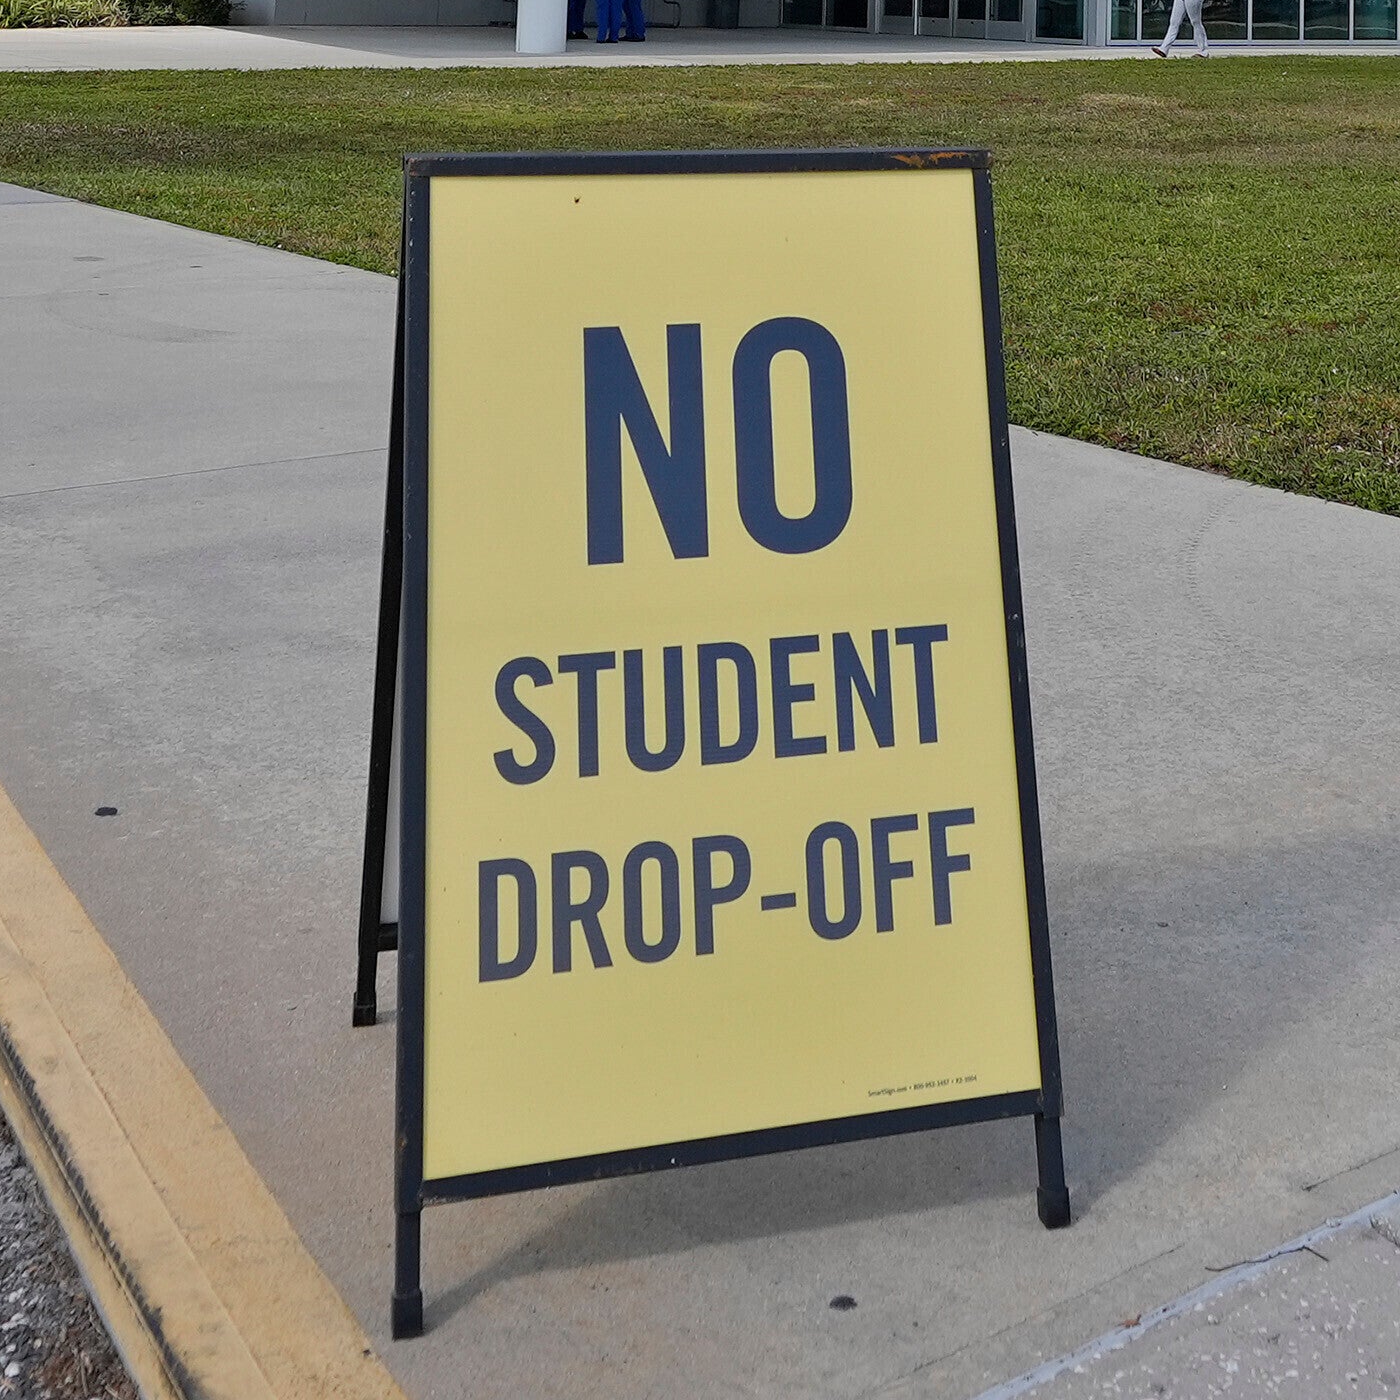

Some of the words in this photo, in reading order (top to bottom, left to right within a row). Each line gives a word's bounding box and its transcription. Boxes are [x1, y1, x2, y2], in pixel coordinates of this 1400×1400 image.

[583, 316, 854, 567] NO
[493, 623, 949, 786] STUDENT
[478, 807, 976, 984] DROP-OFF
